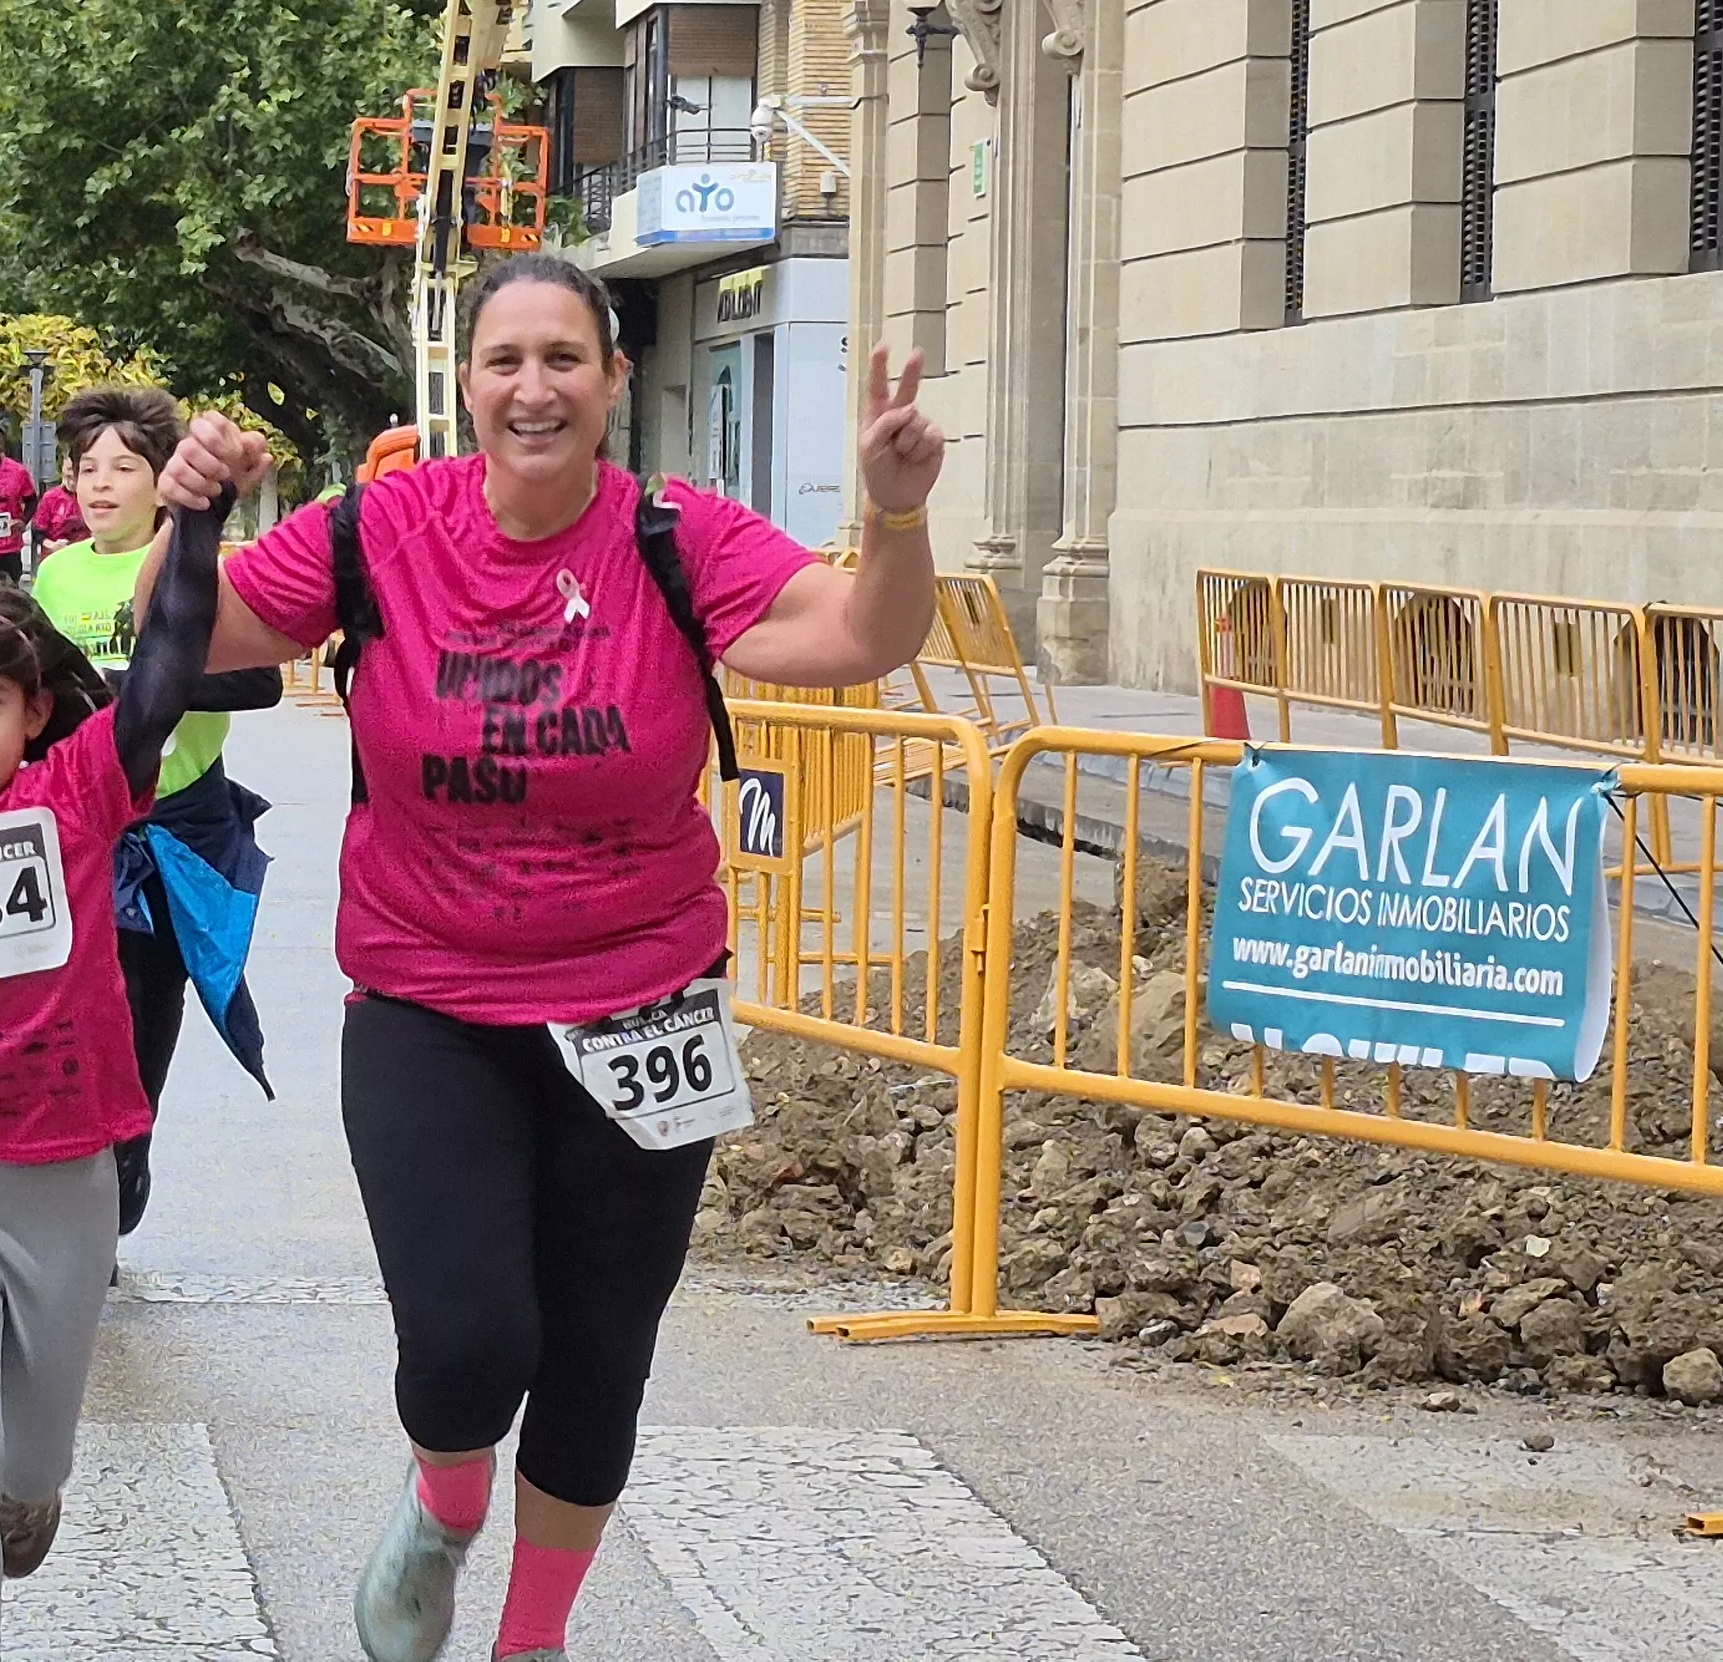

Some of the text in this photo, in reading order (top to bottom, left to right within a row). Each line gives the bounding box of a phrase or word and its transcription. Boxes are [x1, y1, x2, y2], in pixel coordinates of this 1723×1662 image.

[435, 651, 564, 707] UNIDOS
[481, 705, 633, 757] EN CADA
[421, 754, 528, 805] PASO
[1248, 777, 1583, 897] GARLAN
[1237, 876, 1571, 943] SERVICIOS INMOBILIARIOS
[582, 1030, 643, 1053] CONTRA
[643, 1025, 665, 1040] EL
[664, 1007, 715, 1032] CÁNCER
[608, 1033, 714, 1112] 396
